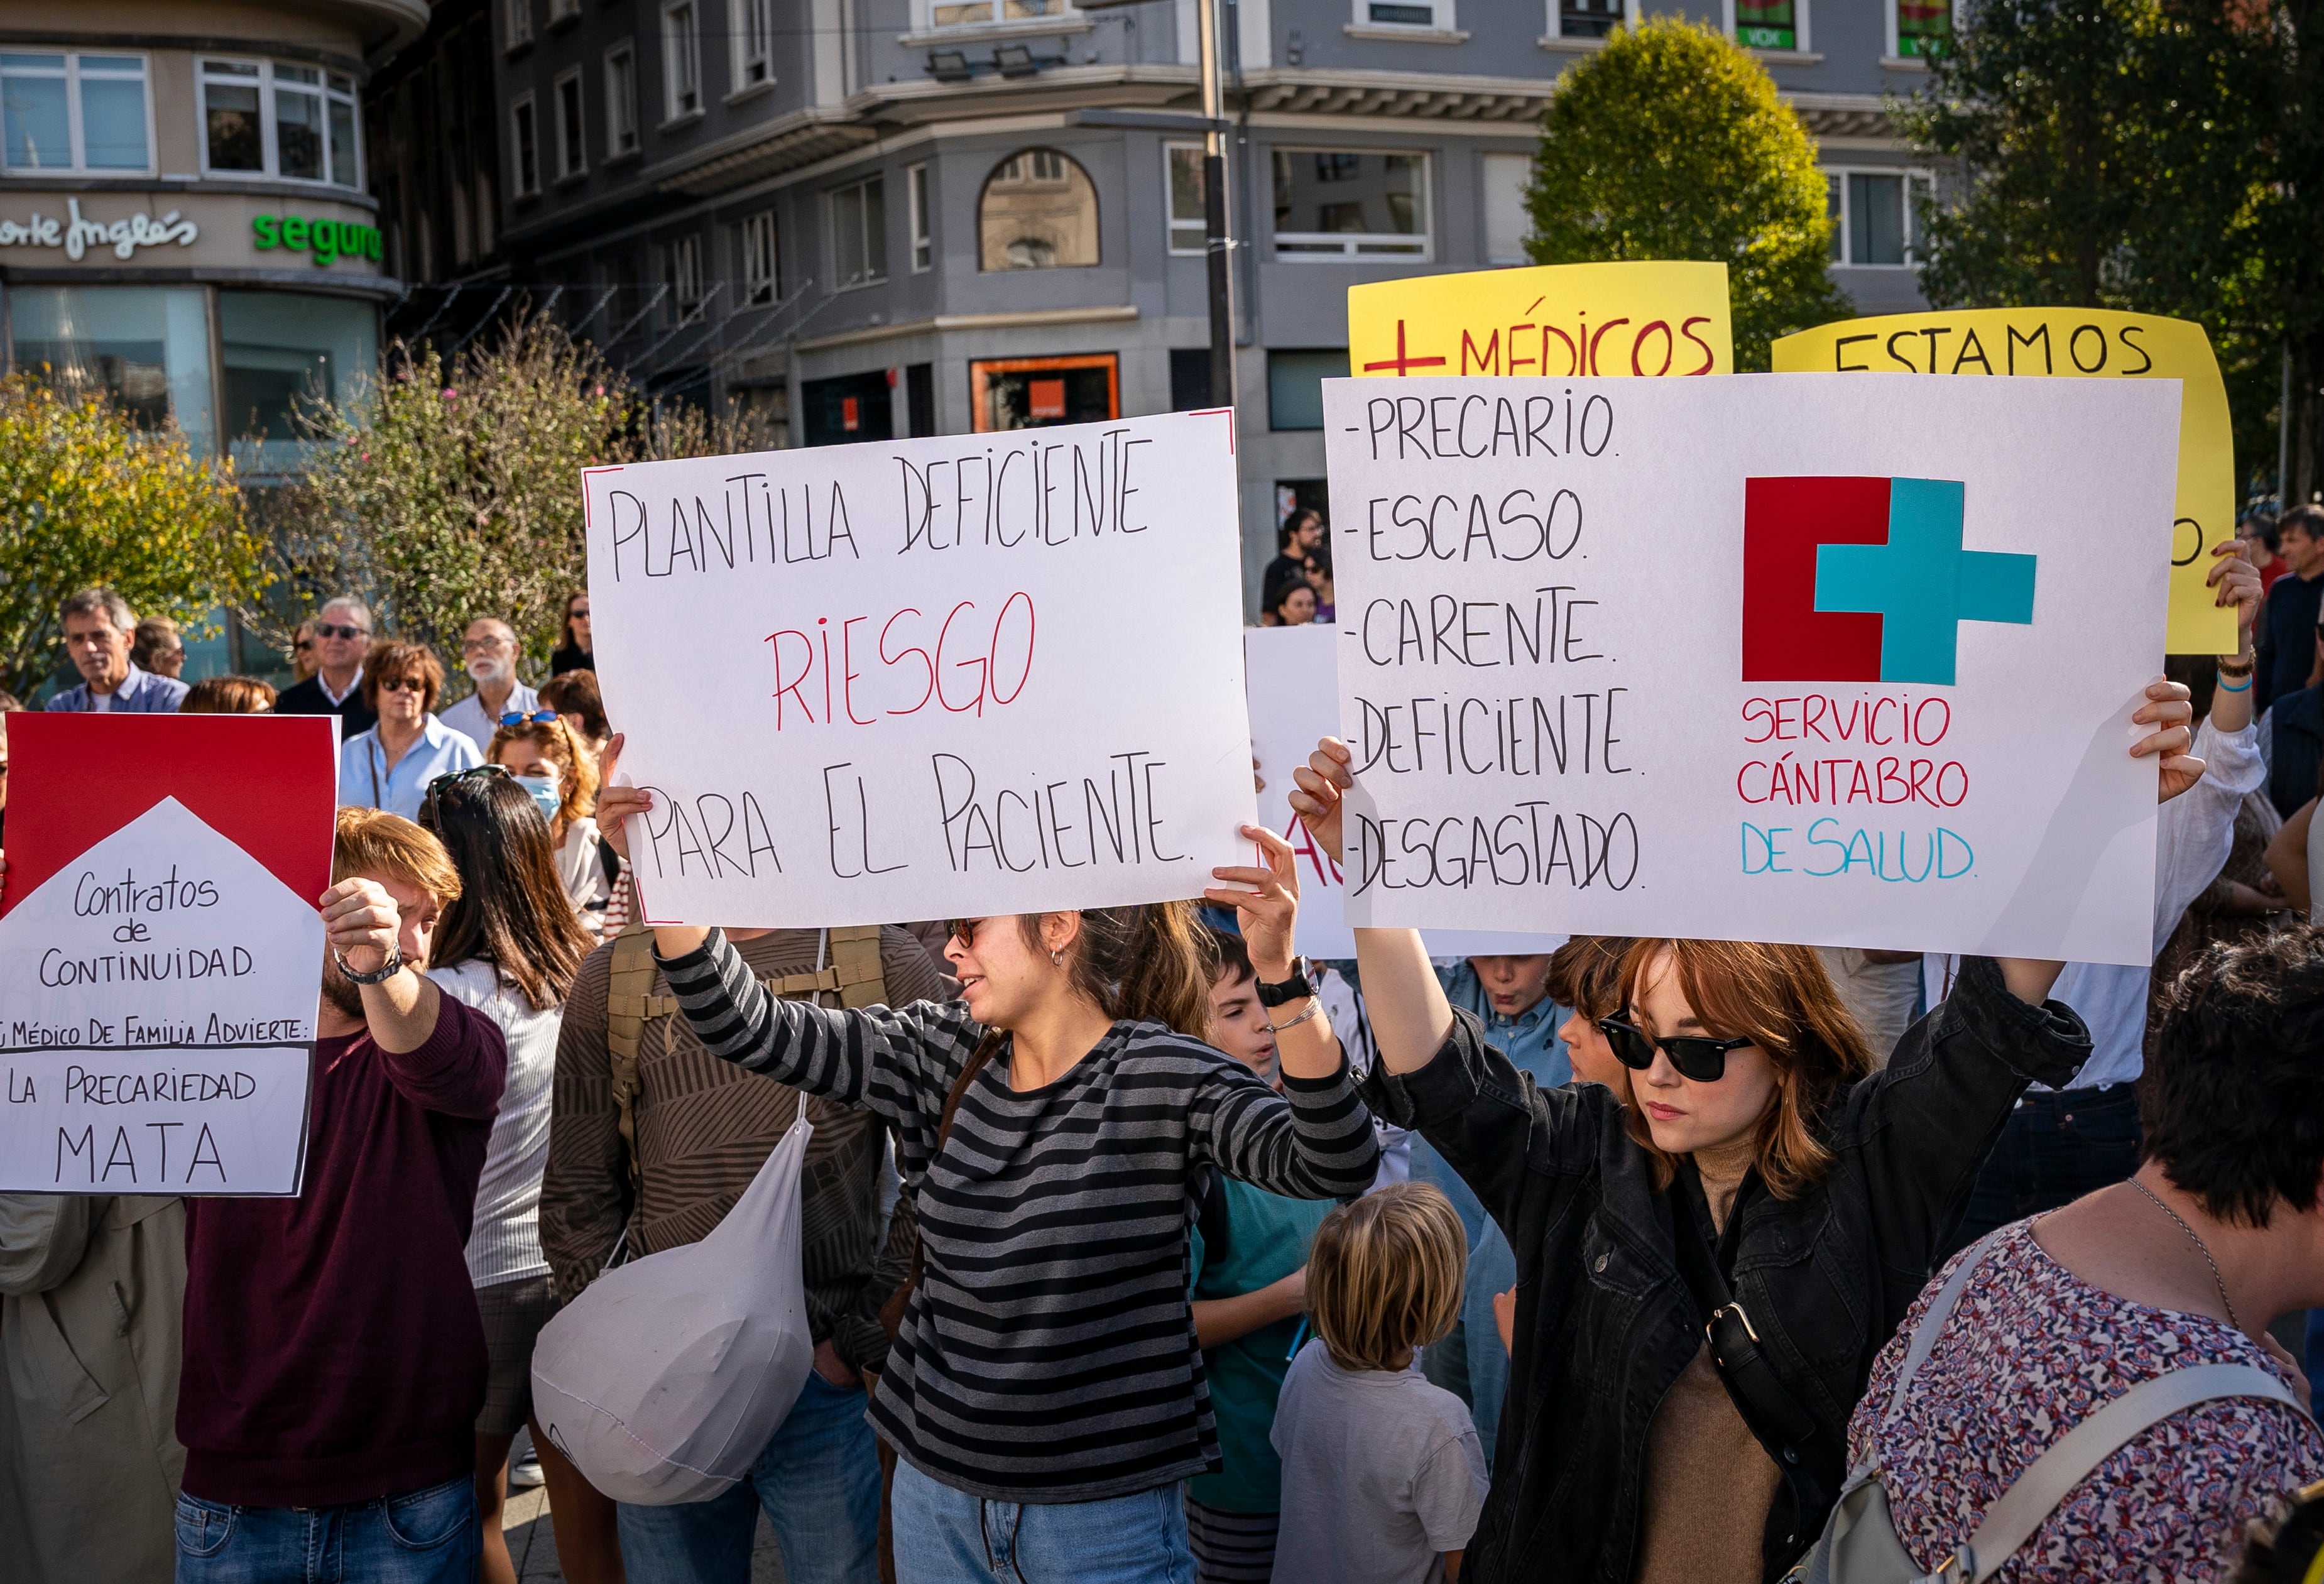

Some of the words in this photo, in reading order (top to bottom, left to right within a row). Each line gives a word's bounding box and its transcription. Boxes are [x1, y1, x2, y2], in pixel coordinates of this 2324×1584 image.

[1747, 27, 1781, 46] VOX
[65, 195, 198, 261] Inglés
[1461, 295, 1715, 376] MÉDICOS
[1835, 322, 2152, 376] ESTAMOS
[1737, 751, 1968, 809] CÁNTABRO
[642, 785, 783, 880] PARA
[823, 762, 909, 878] EL
[1741, 821, 1793, 875] DE
[1803, 817, 1978, 883] SALUD.
[74, 863, 219, 918] Contratos
[112, 917, 152, 944] de
[89, 1018, 115, 1045] DE
[8, 1067, 36, 1103] LA
[55, 1122, 227, 1184] MATA
